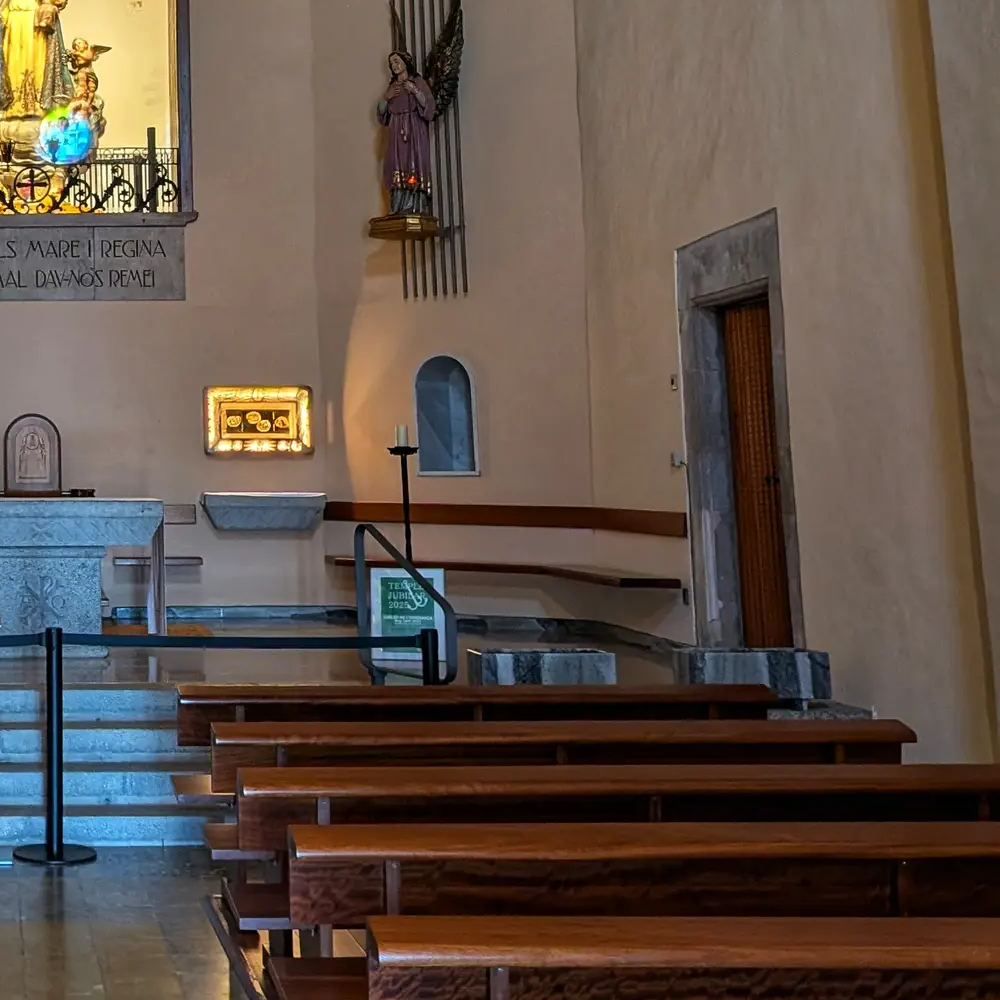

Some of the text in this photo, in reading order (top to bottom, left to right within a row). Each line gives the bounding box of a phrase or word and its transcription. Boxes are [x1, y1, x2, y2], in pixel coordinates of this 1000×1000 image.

[25, 240, 81, 259] MARE
[87, 240, 92, 258] I
[100, 240, 167, 258] REGINA
[109, 269, 156, 288] REMEI
[388, 601, 409, 609] 2025
